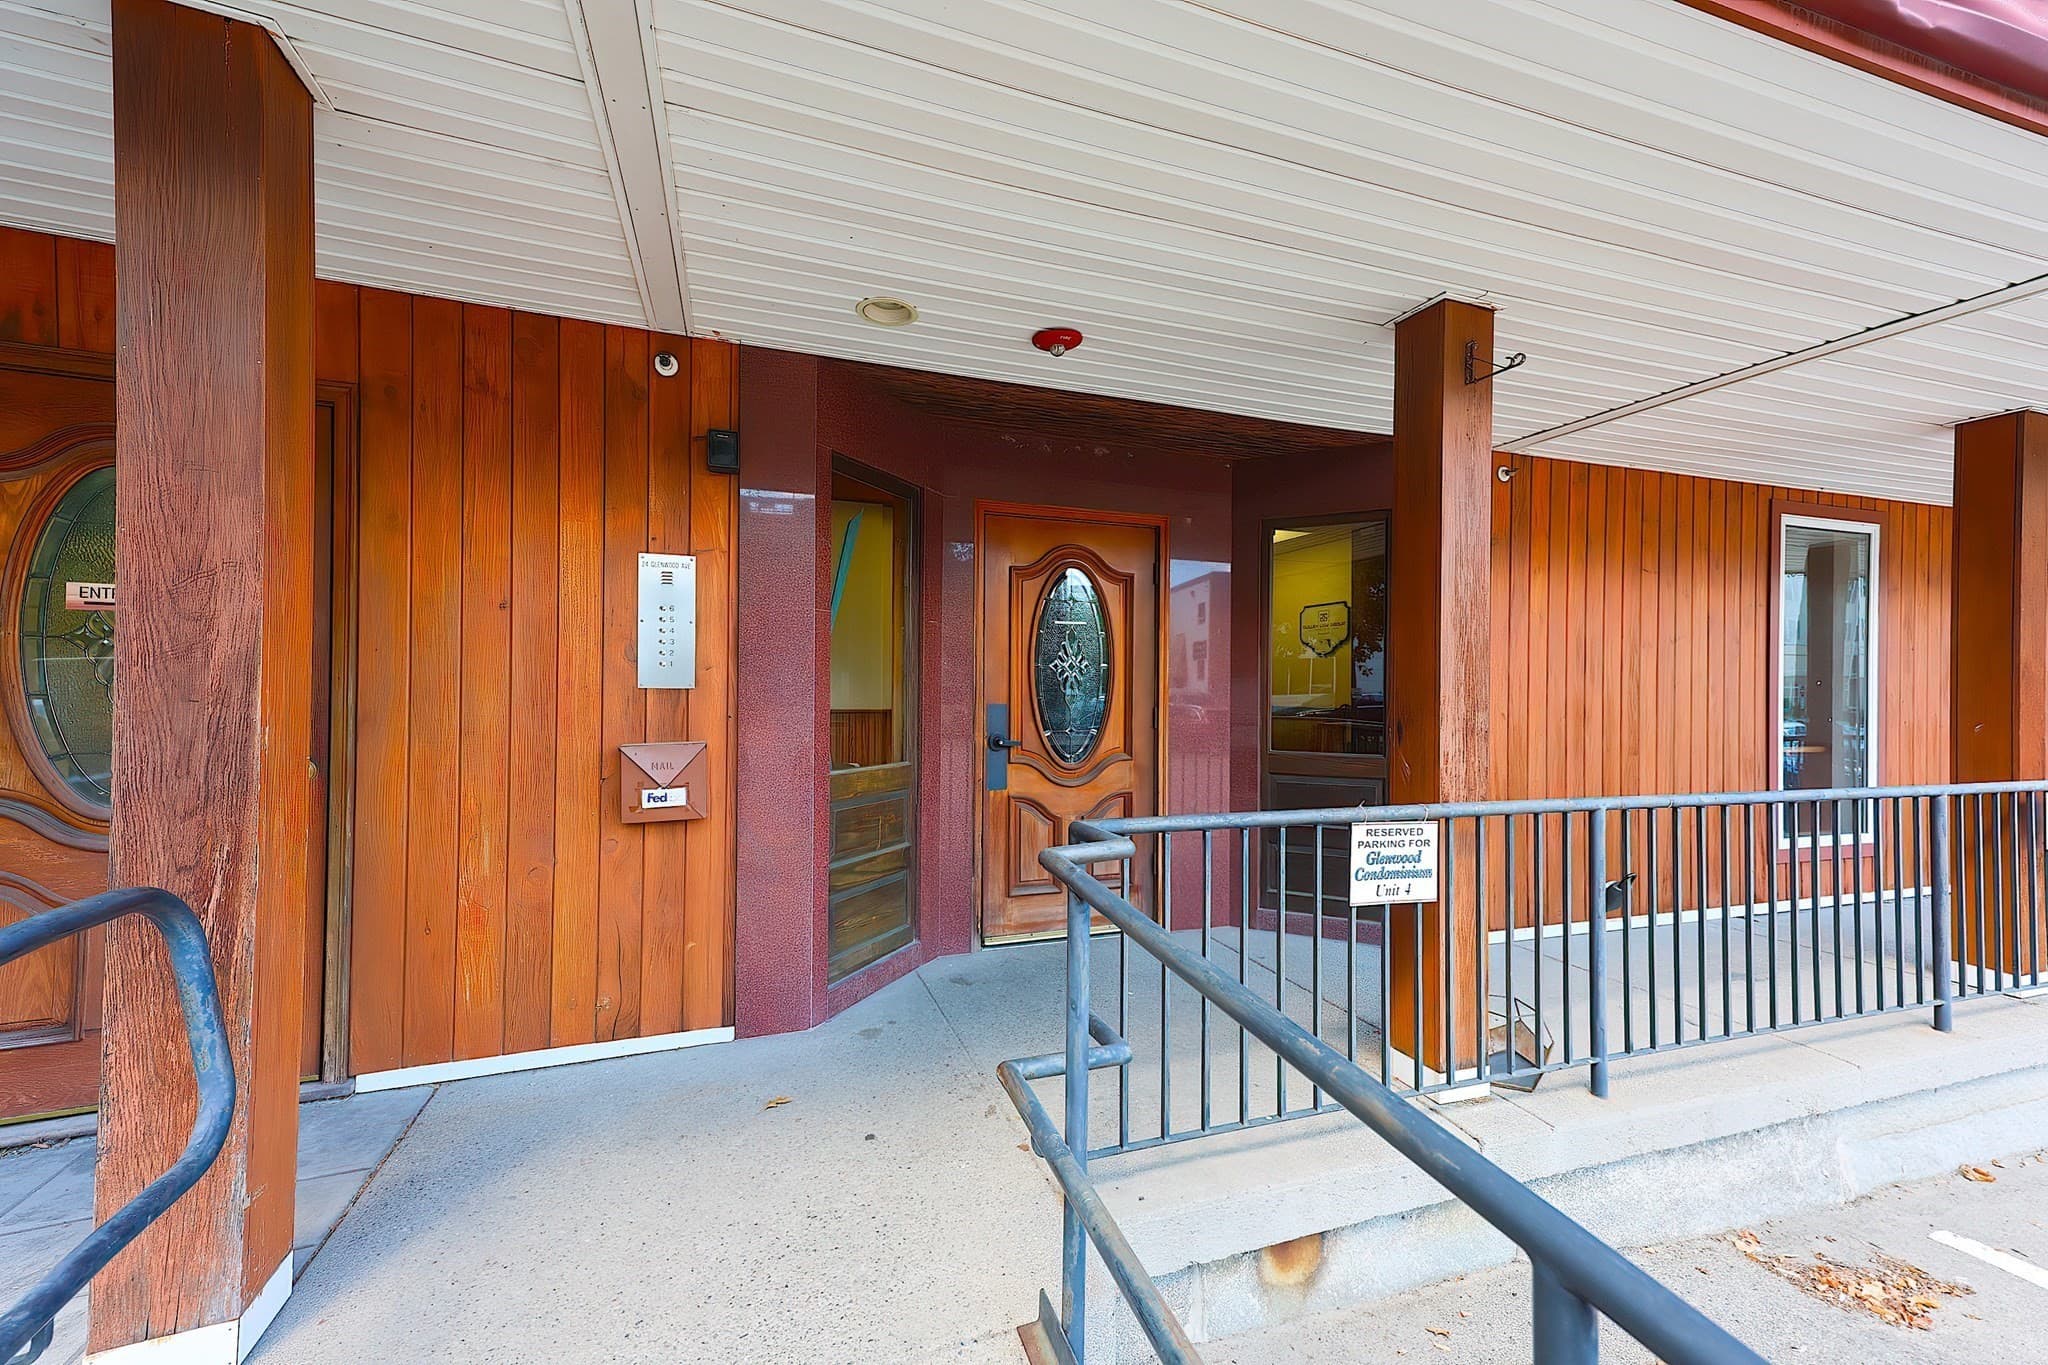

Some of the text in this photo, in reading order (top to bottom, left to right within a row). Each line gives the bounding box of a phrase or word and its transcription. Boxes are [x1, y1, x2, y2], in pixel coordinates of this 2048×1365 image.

[651, 560, 680, 569] GLENWOOD
[651, 761, 675, 771] MAIL
[1366, 828, 1424, 837] RESERVED
[1357, 839, 1431, 849] PARKING FOR
[1366, 850, 1422, 866] Glenwood
[1354, 865, 1433, 881] Condominium
[1376, 882, 1411, 897] Unit 4
